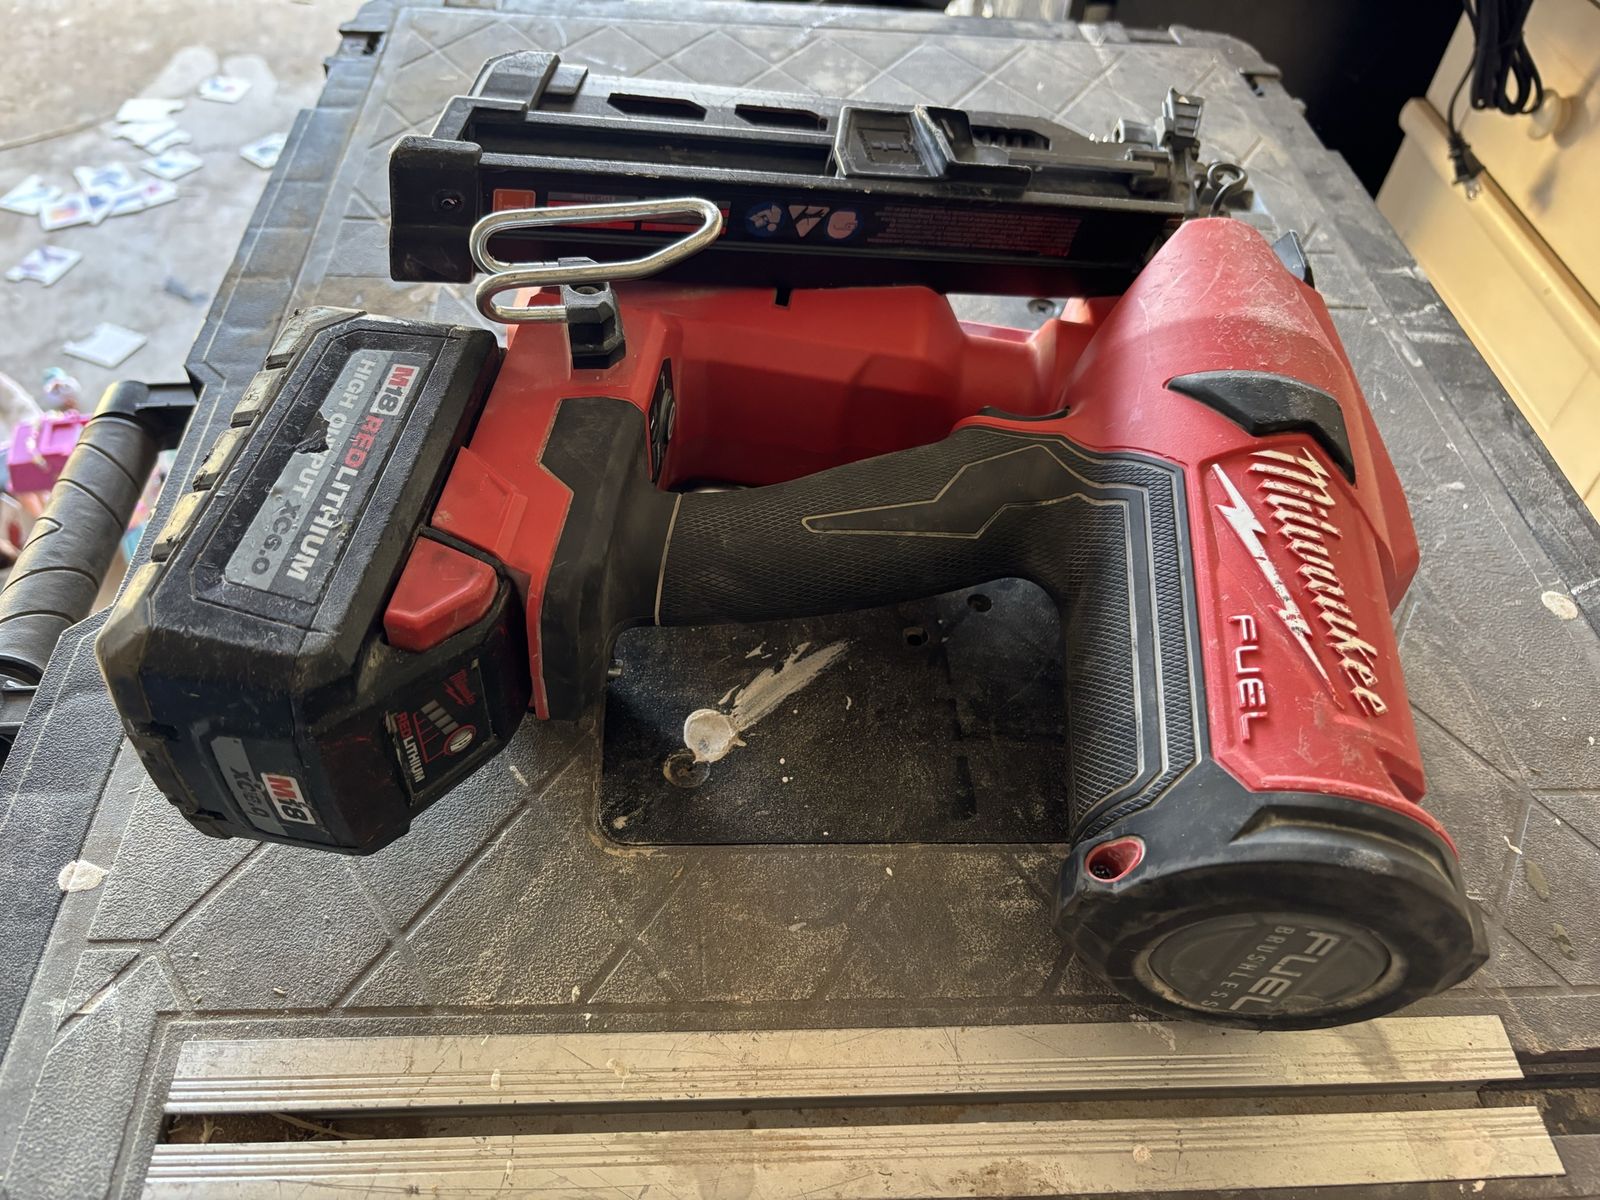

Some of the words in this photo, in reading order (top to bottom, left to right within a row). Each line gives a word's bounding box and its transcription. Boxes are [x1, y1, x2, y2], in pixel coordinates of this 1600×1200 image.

[337, 359, 376, 410] HIGH
[381, 366, 414, 413] M18
[252, 501, 301, 575] XC6.0
[1247, 447, 1388, 717] Milwaukee
[1228, 614, 1269, 743] FUEL
[395, 712, 426, 783] REDLITHIUM
[267, 776, 308, 821] M18
[1201, 926, 1295, 1007] BRUSHLESS
[1230, 931, 1341, 1011] FUEL
